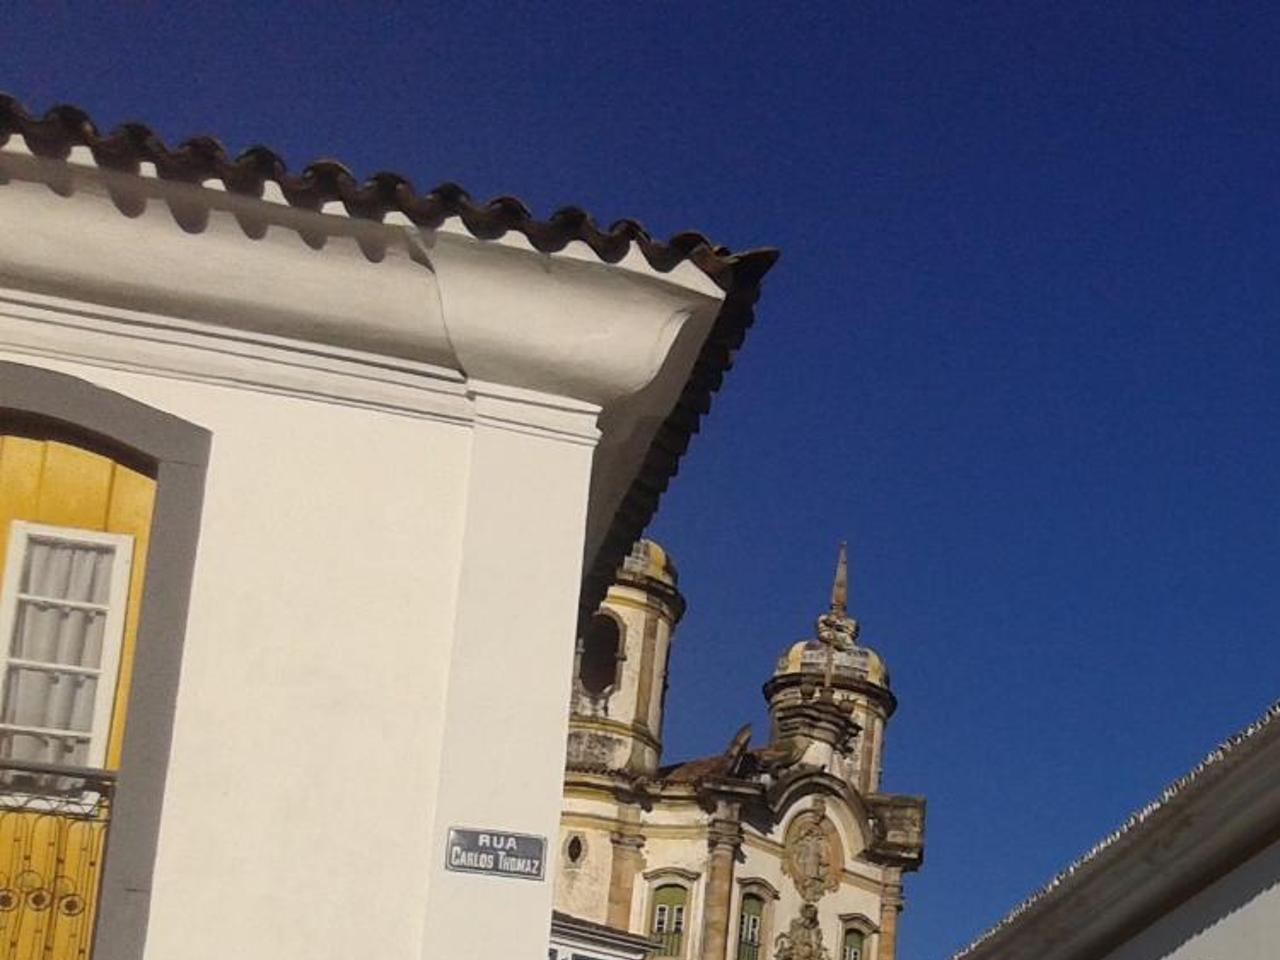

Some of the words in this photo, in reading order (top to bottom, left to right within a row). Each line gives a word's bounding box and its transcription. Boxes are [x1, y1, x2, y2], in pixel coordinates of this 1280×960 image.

[478, 834, 518, 850] RUA
[451, 845, 495, 870] CARLOS
[497, 850, 541, 875] THOMAZ
